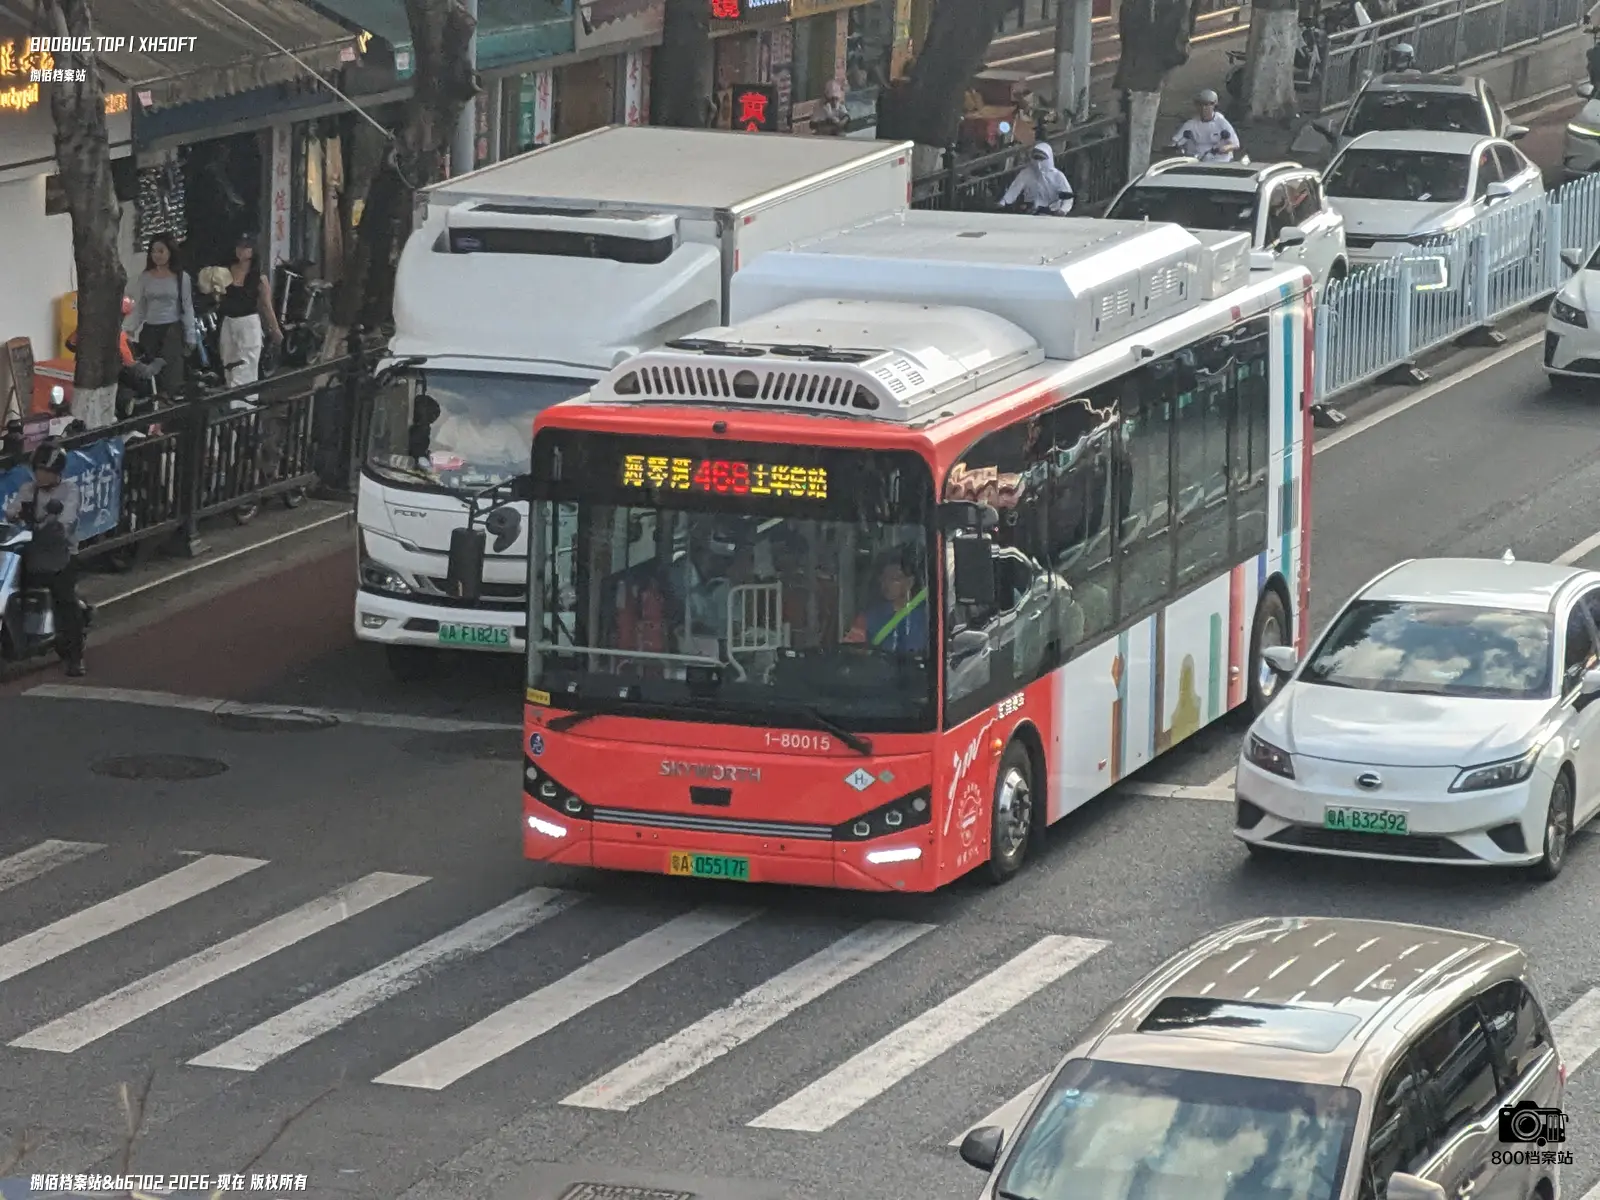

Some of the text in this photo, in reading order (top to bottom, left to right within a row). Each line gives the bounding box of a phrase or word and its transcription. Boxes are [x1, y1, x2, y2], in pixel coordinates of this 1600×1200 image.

[739, 92, 768, 132] 黄
[764, 732, 831, 752] 1-80015
[658, 759, 761, 782] SKYWORTH
